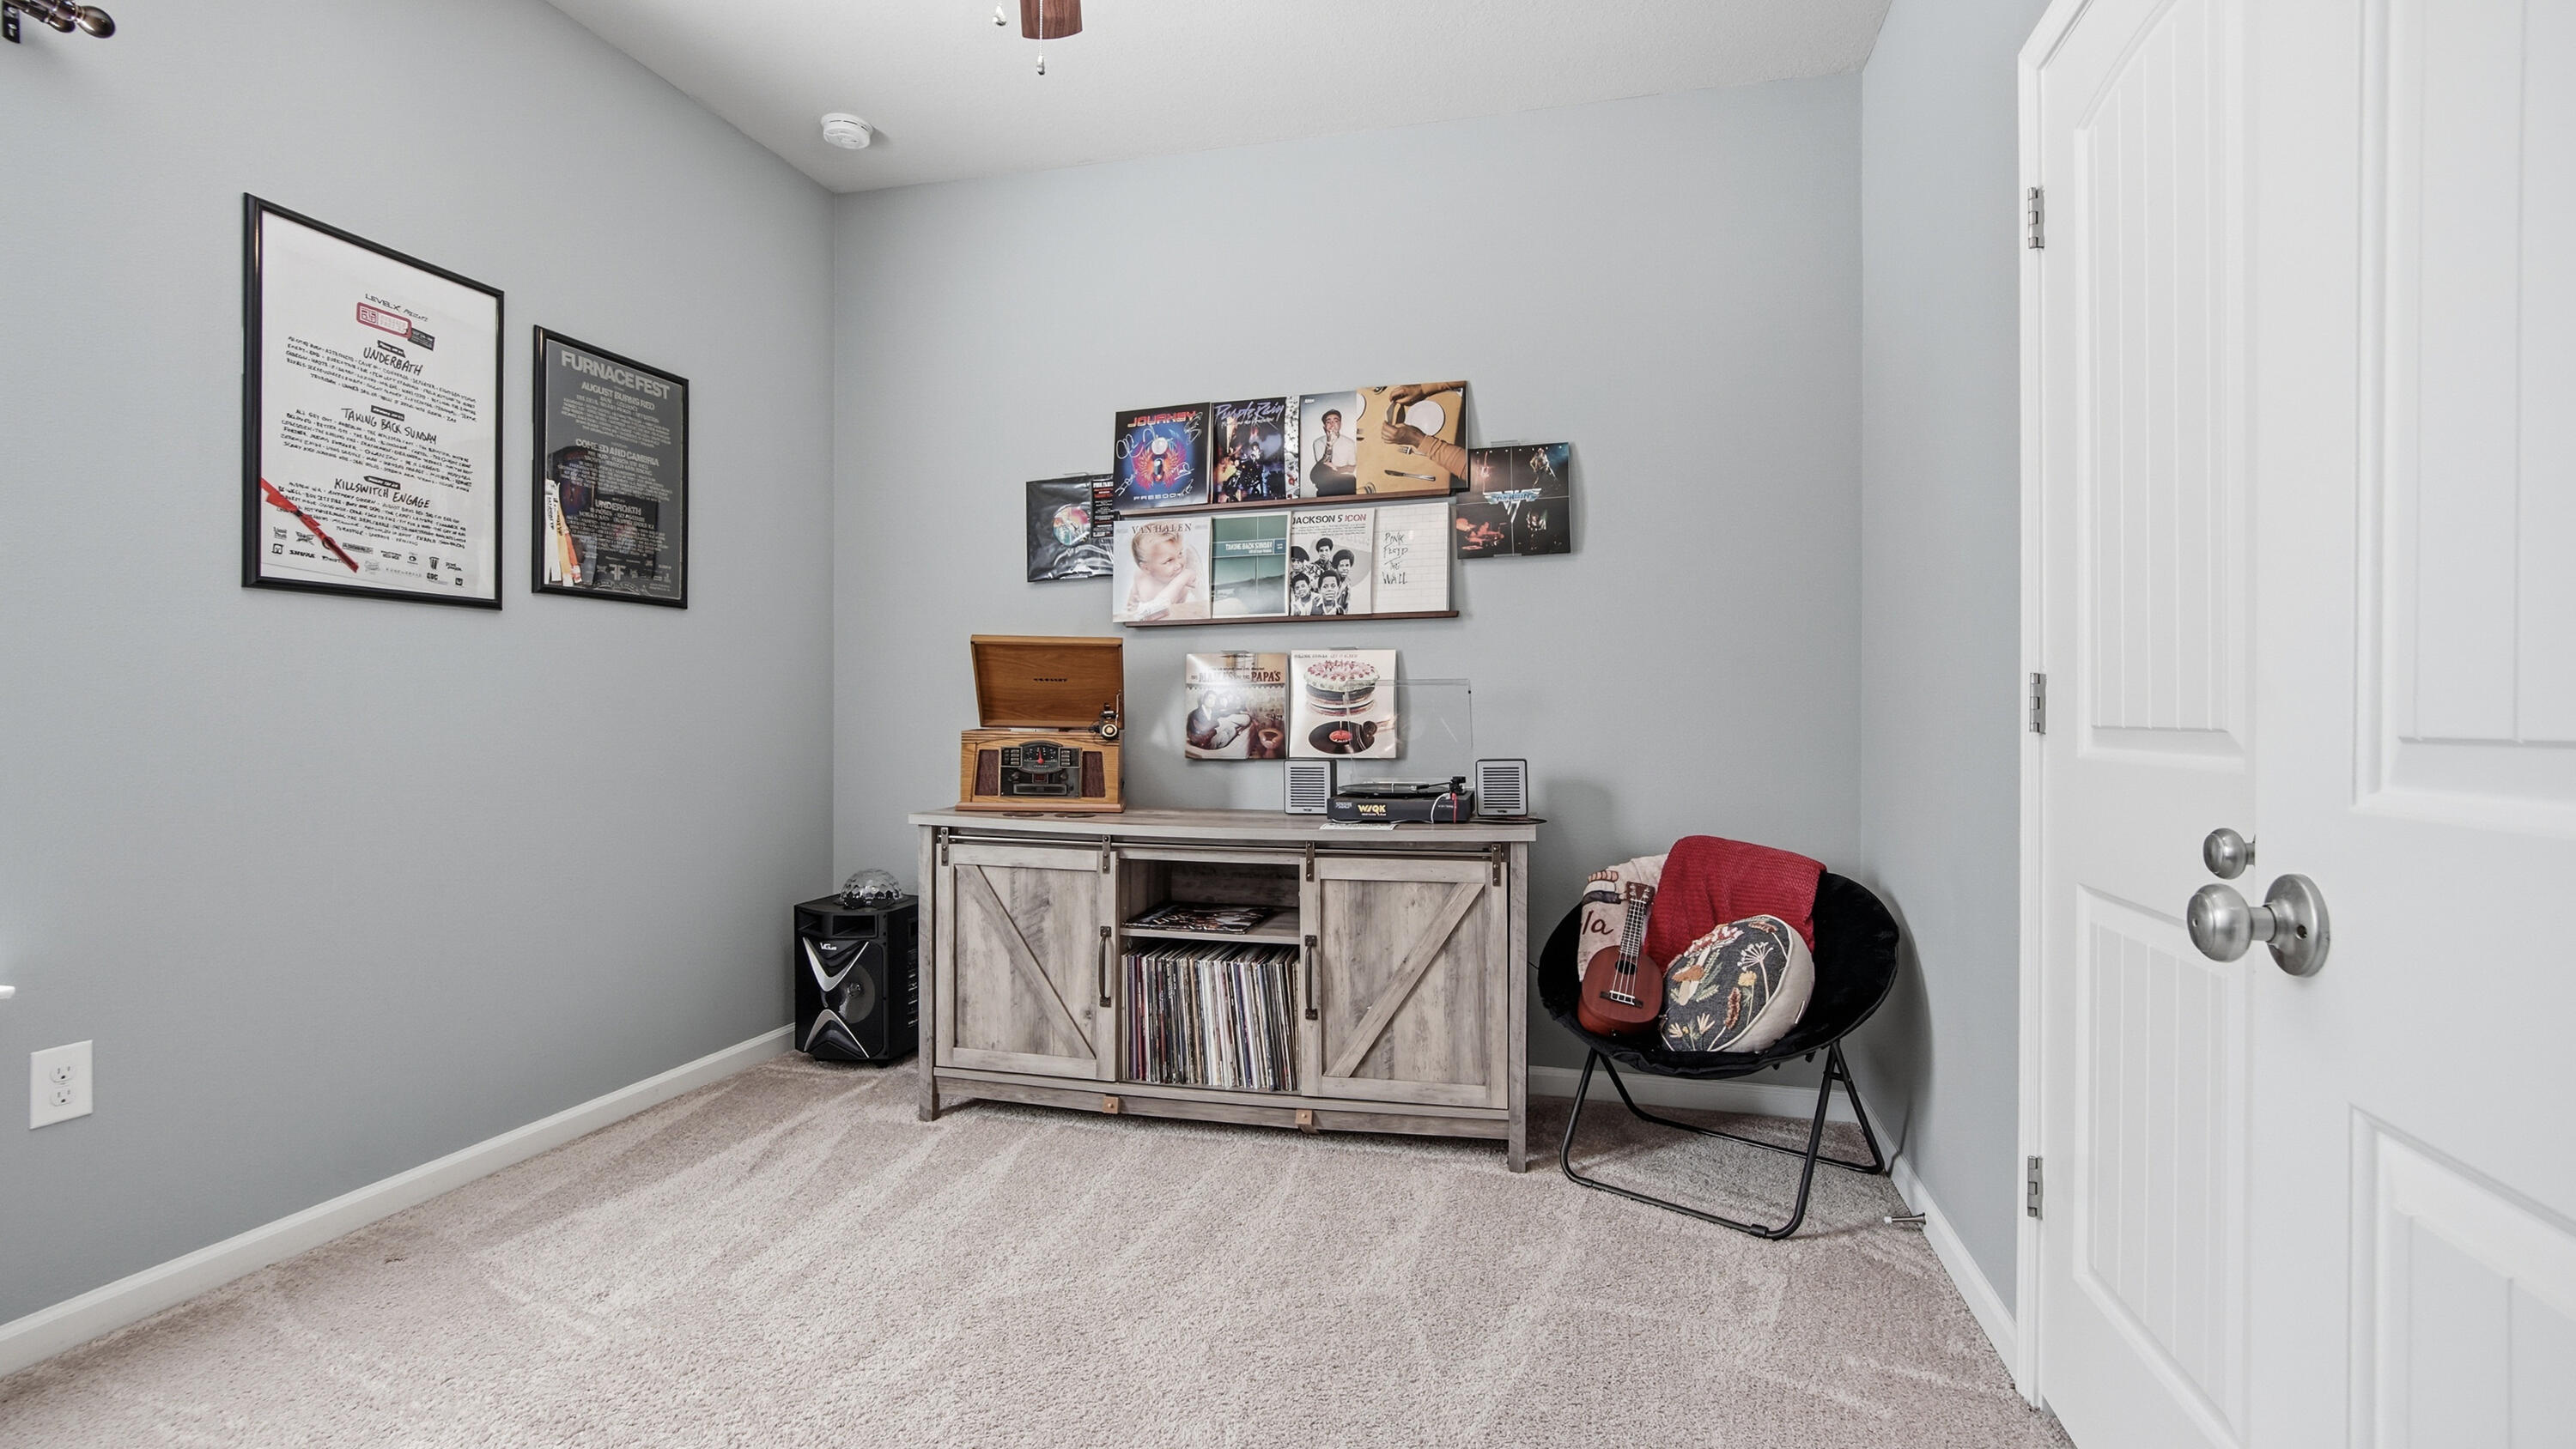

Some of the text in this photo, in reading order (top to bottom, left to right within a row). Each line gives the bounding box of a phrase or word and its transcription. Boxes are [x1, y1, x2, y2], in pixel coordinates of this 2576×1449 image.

[561, 350, 670, 399] FURNACE FEST
[581, 381, 613, 397] AUGUST
[614, 391, 640, 405] BURNS
[640, 398, 655, 411] RED
[1127, 410, 1196, 427] JOURNEY
[1214, 401, 1255, 424] Purple
[1255, 401, 1285, 421] Rain
[341, 408, 377, 427] TAKING
[381, 417, 402, 434] BACK
[404, 427, 437, 444] SUNDAY
[575, 439, 659, 466] COHEED AND CAMBRIA
[334, 478, 390, 499] KILLSWITCH
[392, 492, 431, 509] ENGAGE
[1132, 523, 1193, 535] VAN HALEN
[1292, 515, 1335, 524] JACKSON
[1345, 513, 1367, 522] ICON
[1255, 541, 1273, 549] SUNDAY
[1251, 670, 1281, 682] PAPA'S
